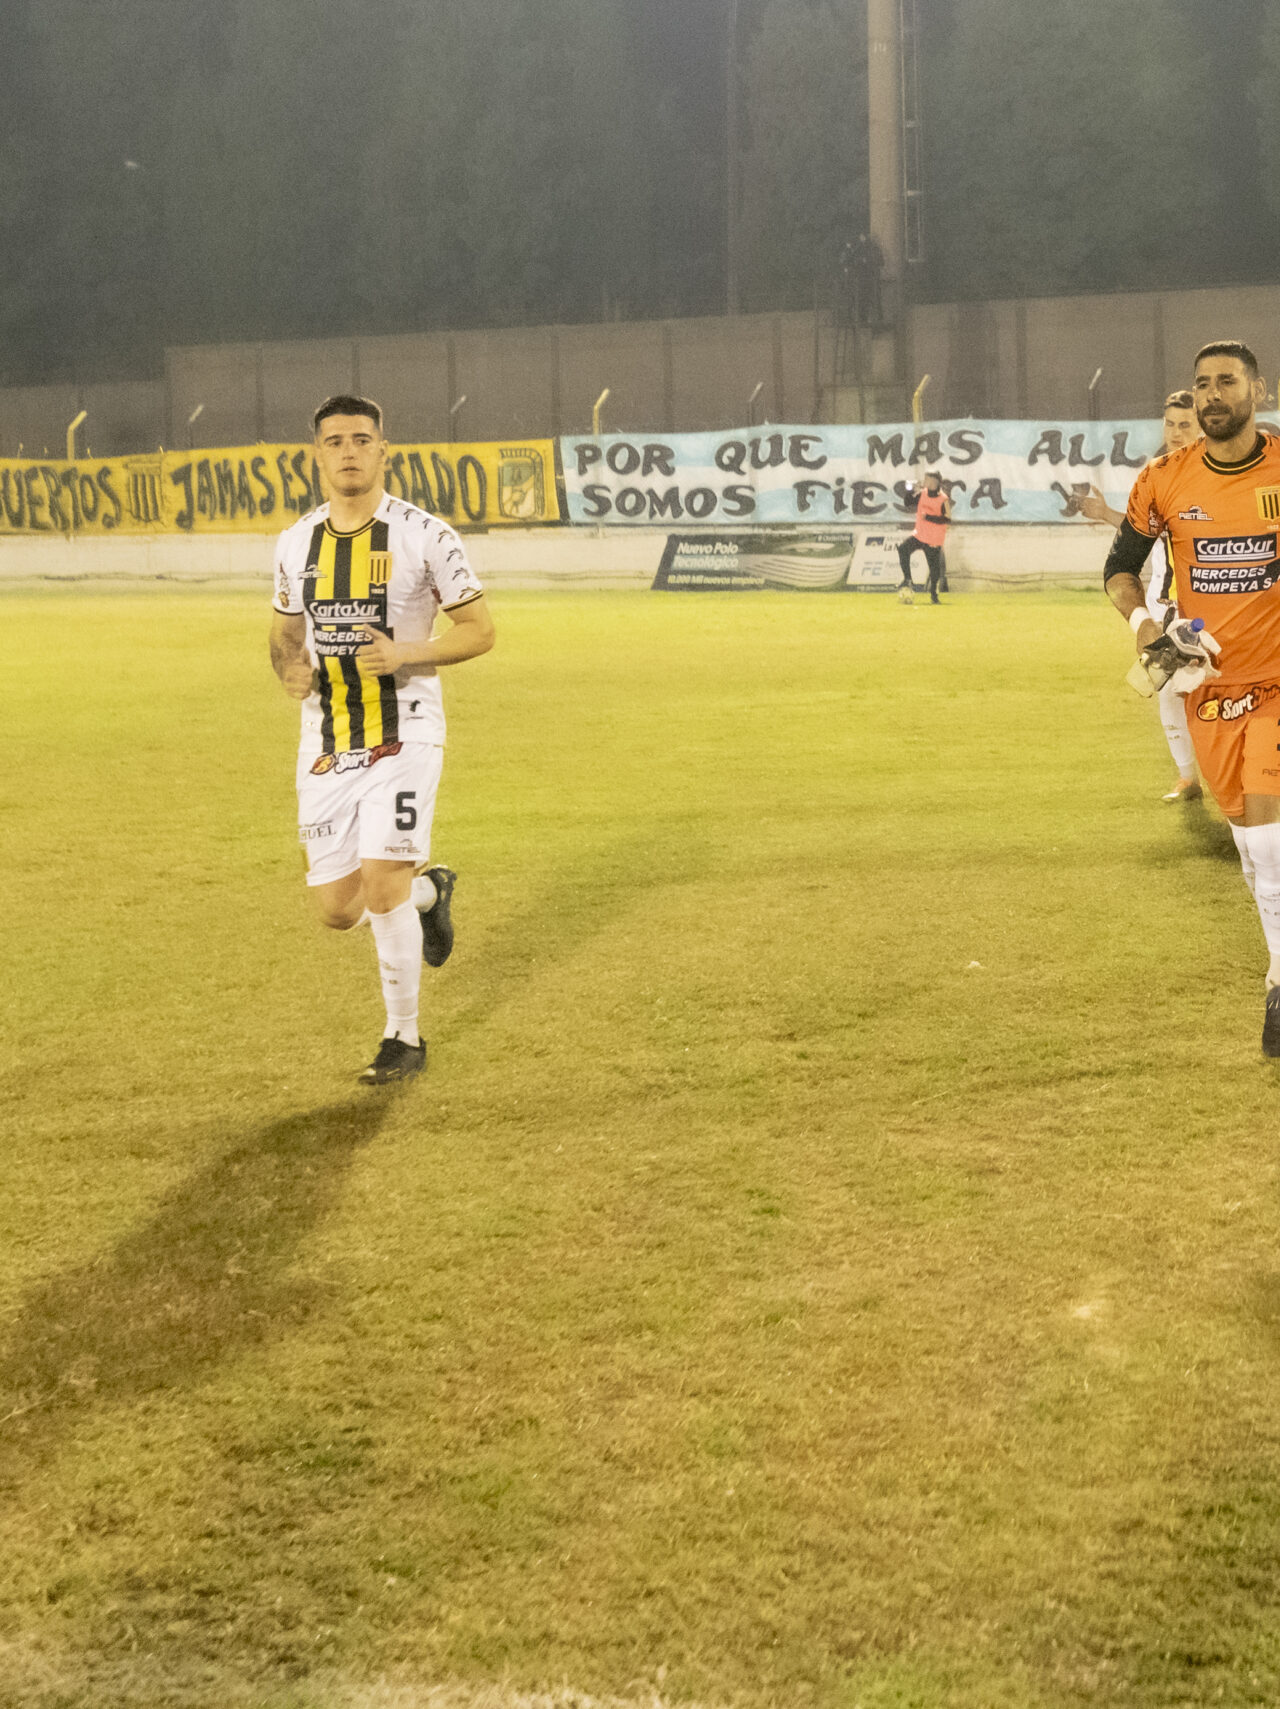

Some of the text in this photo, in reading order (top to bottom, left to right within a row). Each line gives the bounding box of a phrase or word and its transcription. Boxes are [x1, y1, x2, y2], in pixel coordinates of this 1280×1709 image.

[574, 442, 677, 477] POR
[714, 433, 828, 474] QUE
[866, 428, 985, 468] MAS
[1028, 429, 1168, 468] ALL
[0, 466, 121, 531] UERTOS
[170, 456, 275, 532] JAMAS
[581, 482, 757, 519] SOMOS
[676, 541, 739, 554] Nuevo Polo
[1196, 536, 1274, 555] CartaSur
[1191, 564, 1267, 580] MERCEDES
[1192, 579, 1259, 594] POMPEYA
[308, 601, 381, 618] CartaSur
[314, 630, 373, 643] MERCEDES
[395, 791, 417, 831] 5
